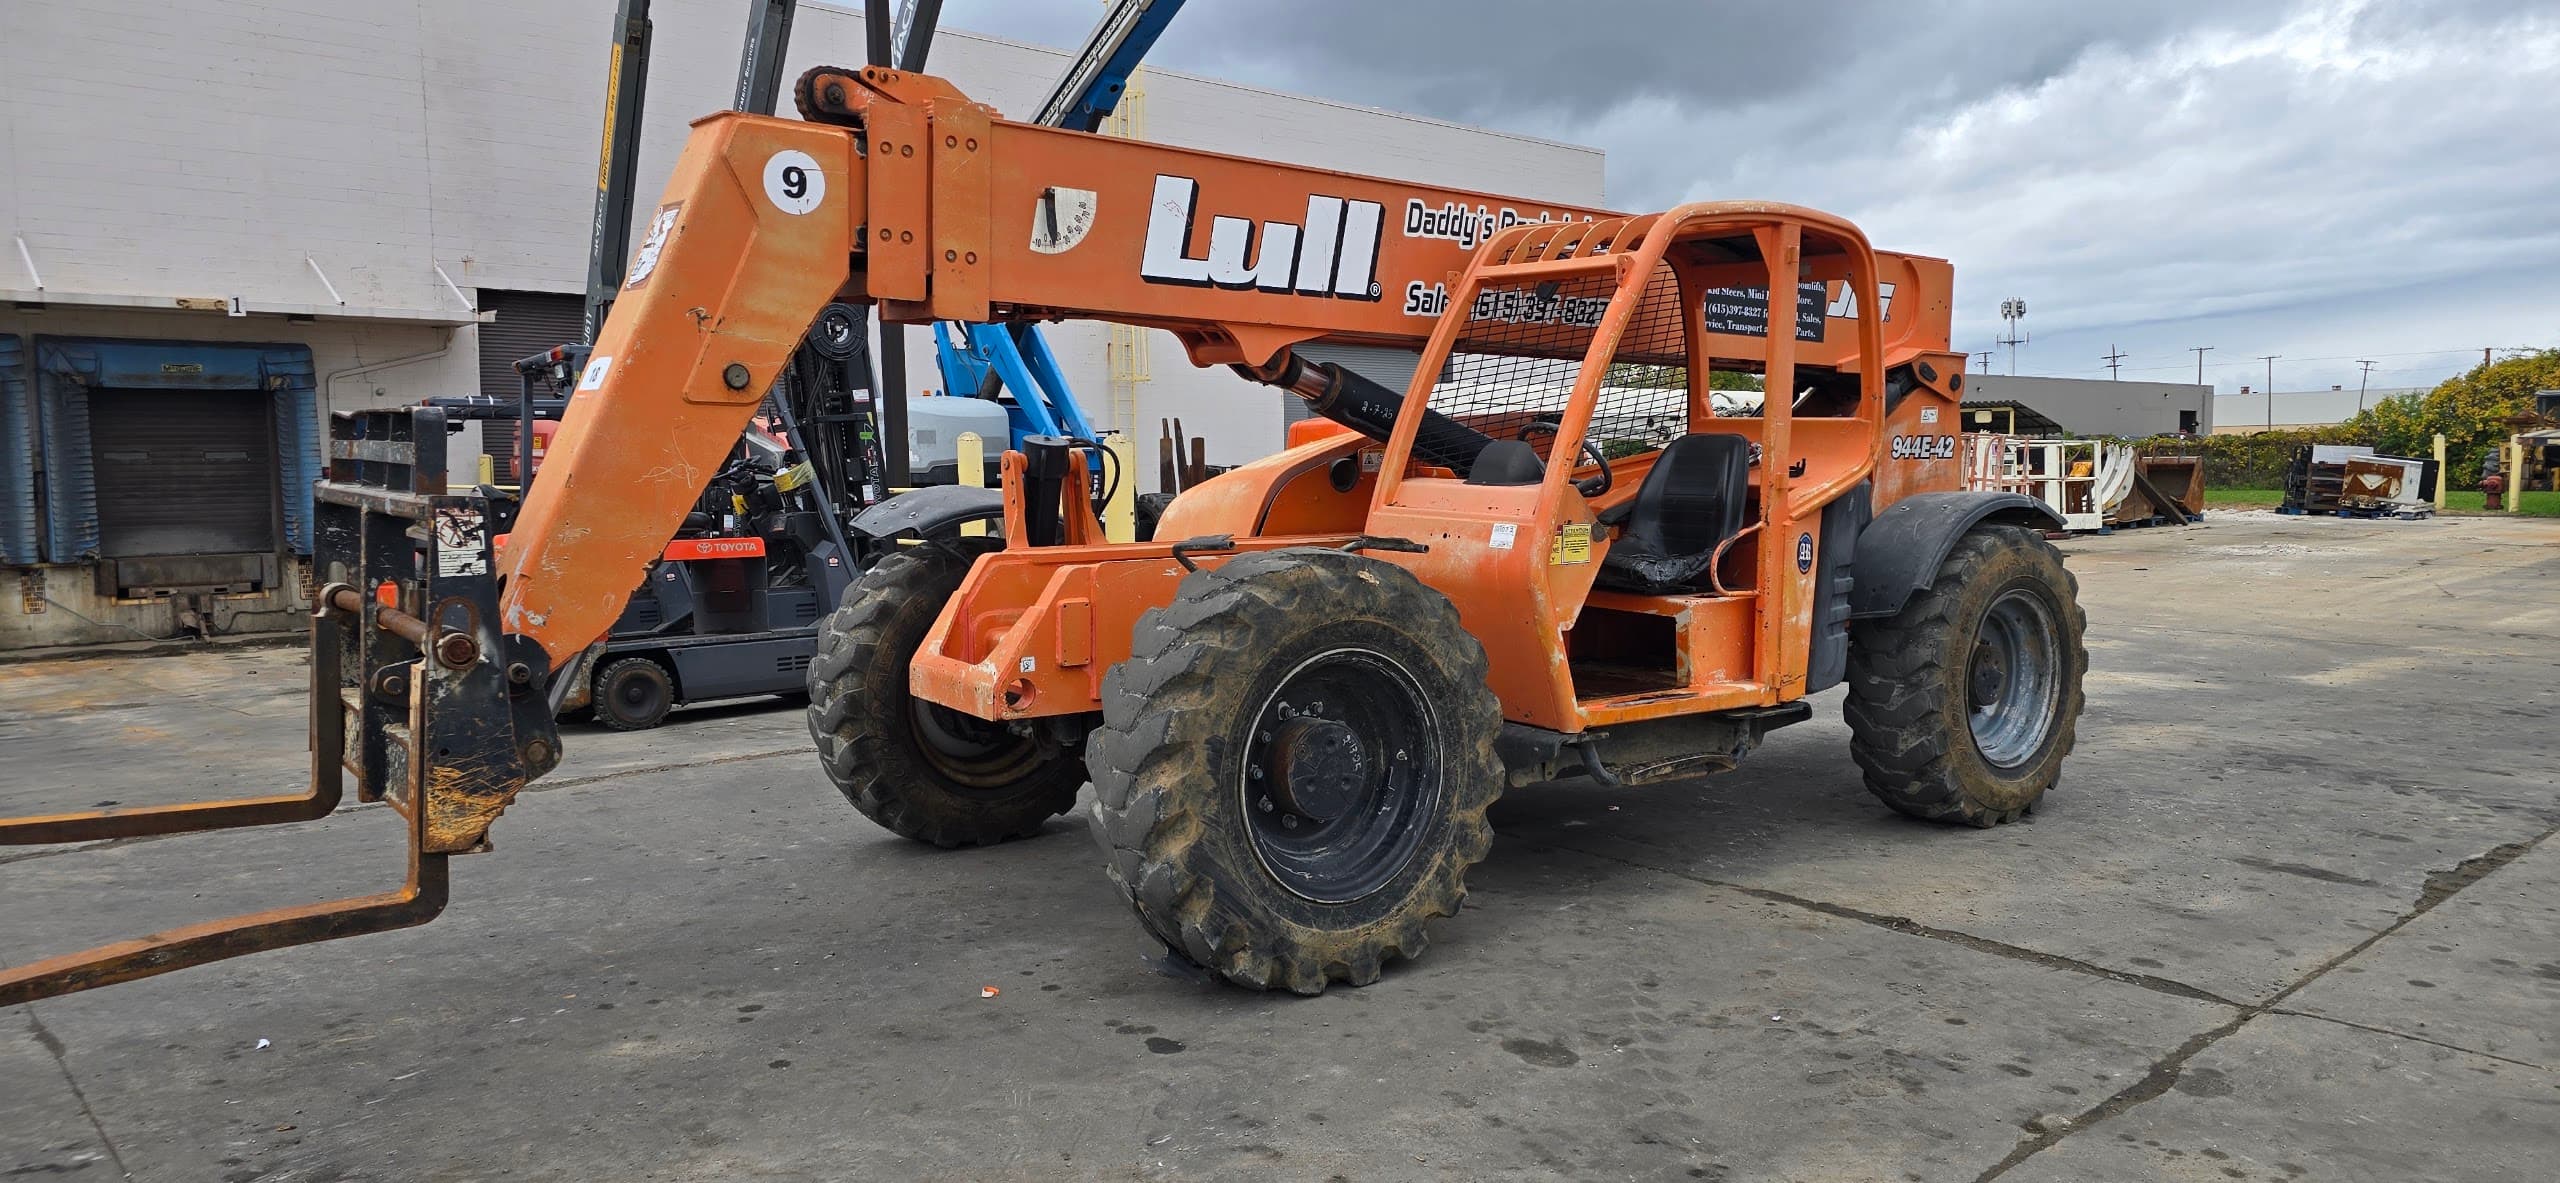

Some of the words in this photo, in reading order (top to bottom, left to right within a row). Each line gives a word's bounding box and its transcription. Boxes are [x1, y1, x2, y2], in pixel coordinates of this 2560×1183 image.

[782, 166, 807, 199] 9
[1406, 201, 1494, 247] Daddy's
[1140, 173, 1386, 302] Lull
[1747, 288, 1765, 300] Mini
[232, 297, 243, 314] 1
[1708, 303, 1762, 318] (615)397-8327
[1802, 312, 1822, 325] Sales,
[1726, 319, 1763, 335] Transport
[1891, 435, 1955, 460] 944E-42
[715, 542, 757, 552] TOYOTA
